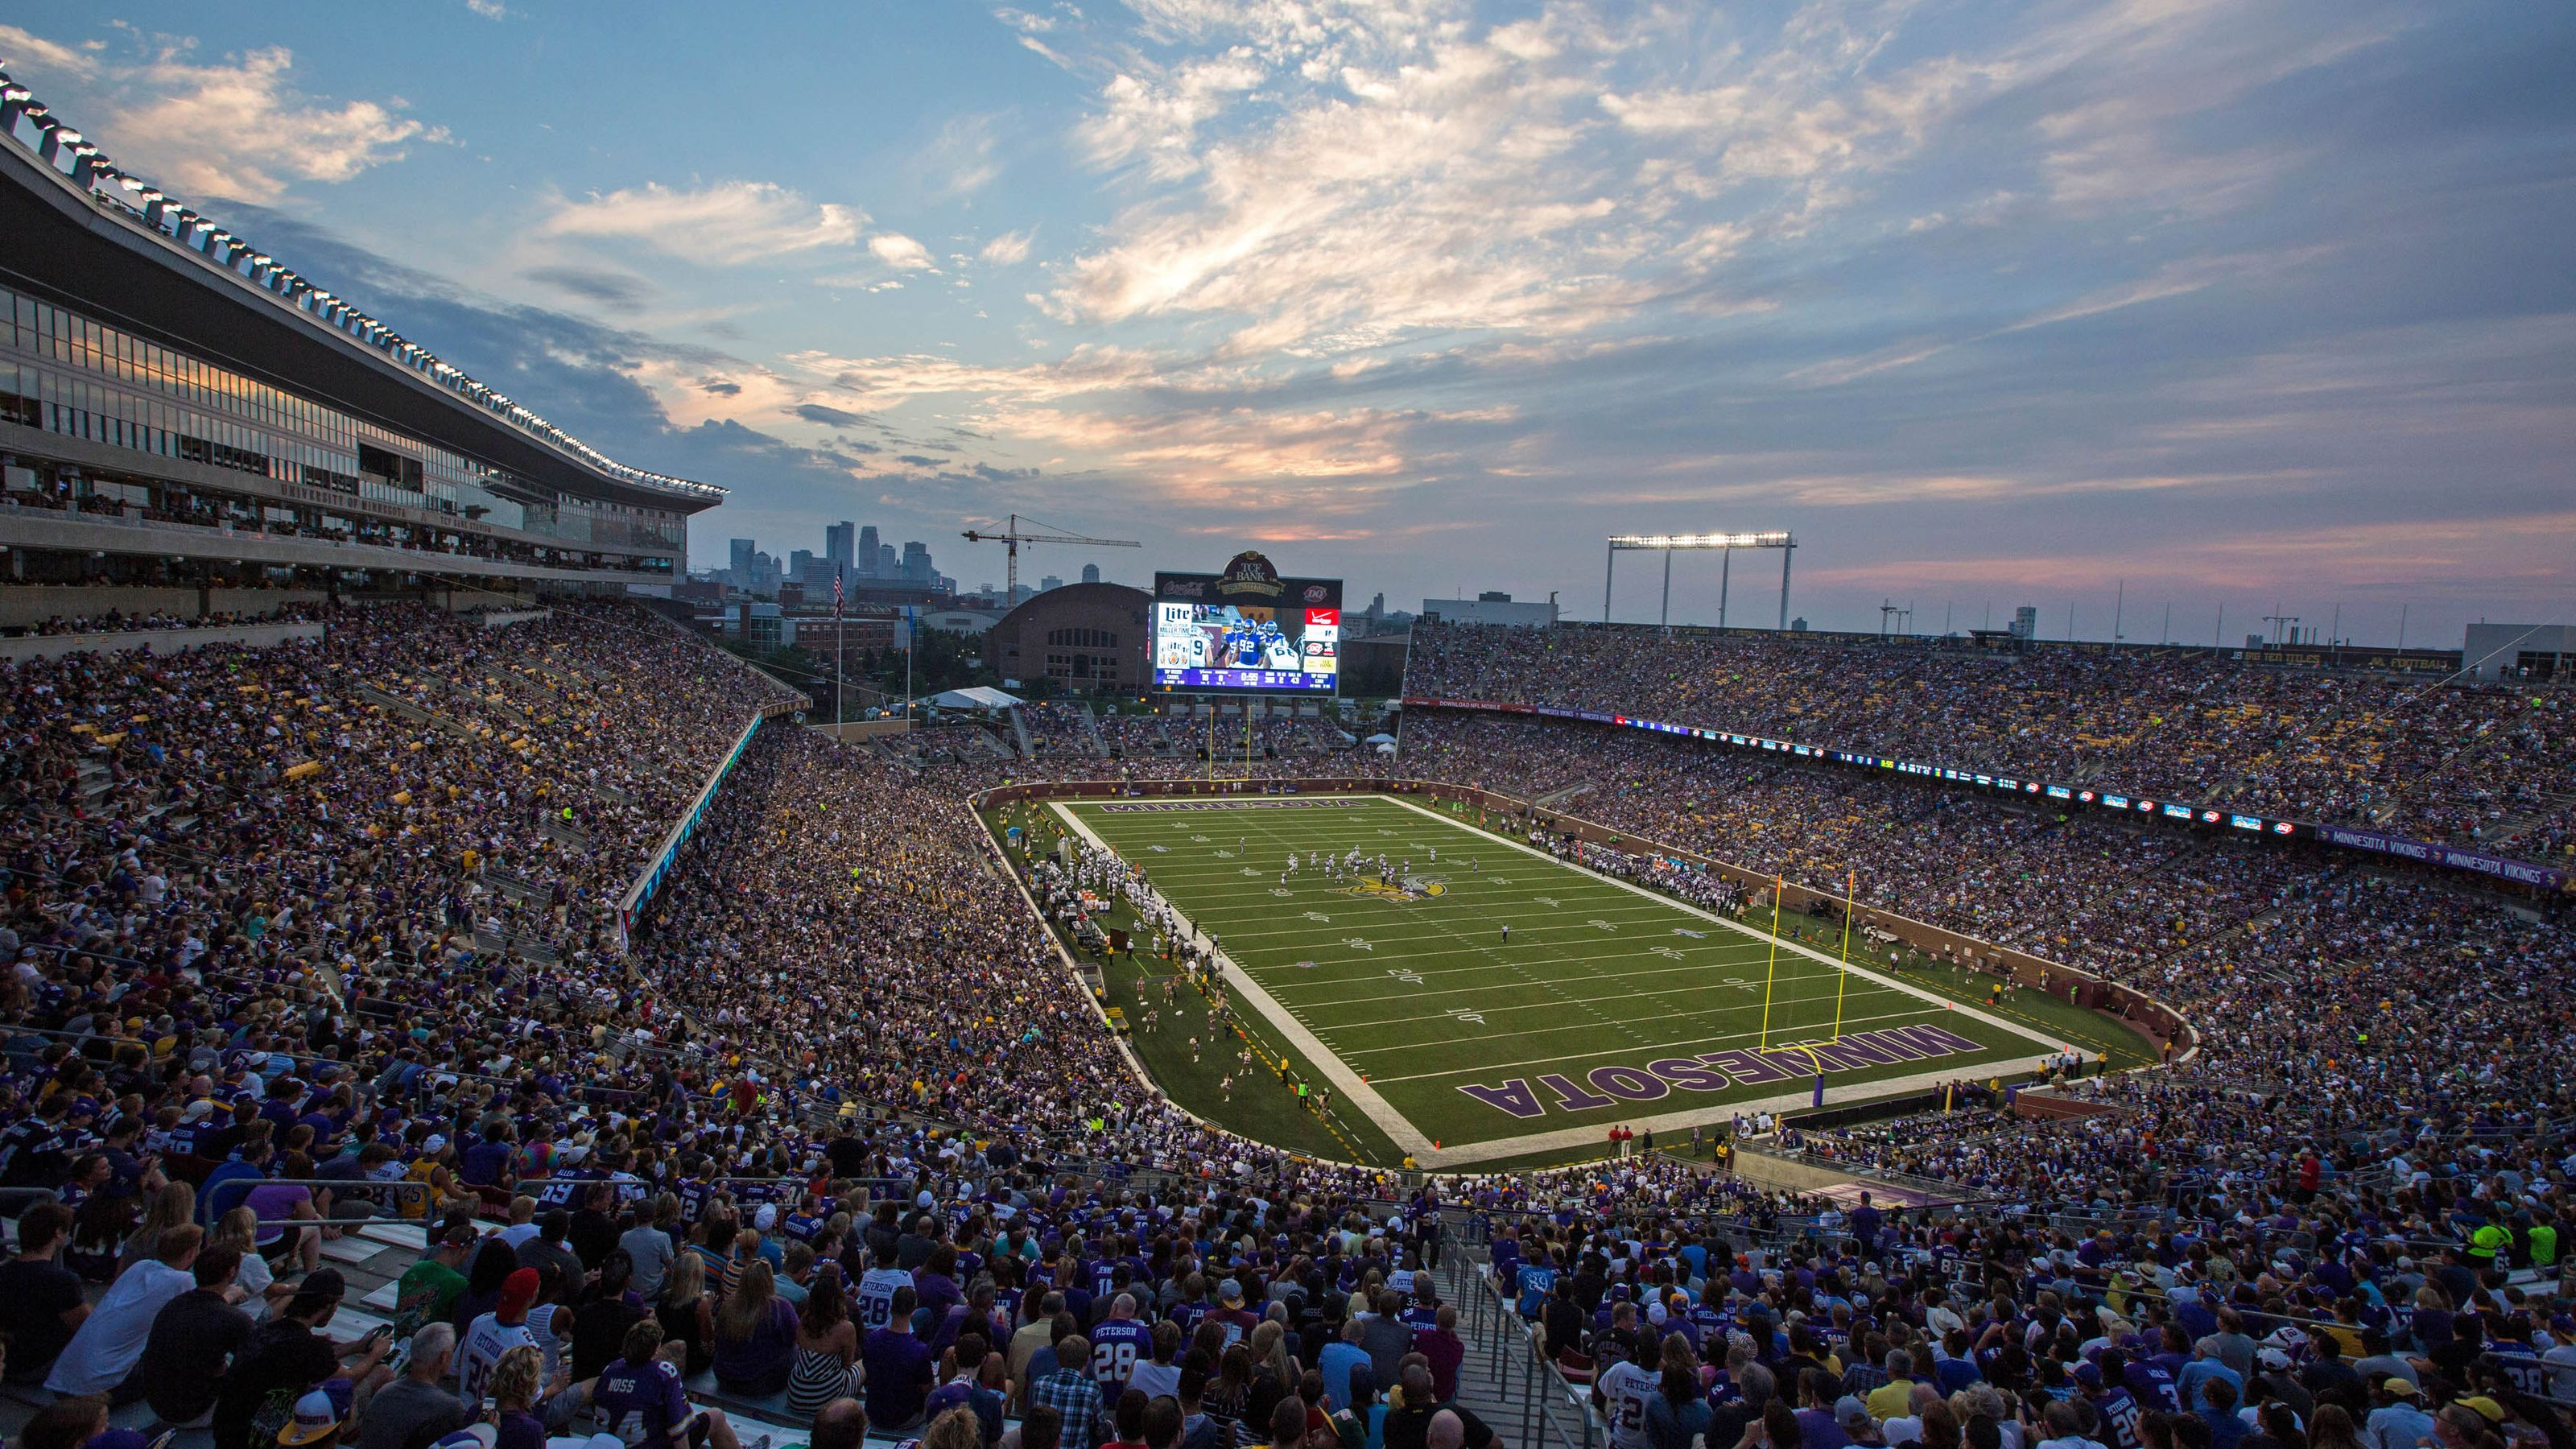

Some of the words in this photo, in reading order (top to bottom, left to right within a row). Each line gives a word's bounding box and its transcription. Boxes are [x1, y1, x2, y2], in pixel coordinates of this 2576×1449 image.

[282, 485, 344, 506] UNIVERSITY
[347, 497, 358, 509] OF
[362, 501, 405, 518] MINNESOTA
[1241, 563, 1261, 572] TCF
[1236, 572, 1265, 581] BANK
[1165, 607, 1190, 622] Lite
[1194, 640, 1203, 655] 9
[1239, 640, 1254, 652] 92
[2244, 651, 2260, 661] BIG
[2264, 653, 2283, 663] TEN
[2285, 654, 2320, 664] TITLES
[1439, 700, 1470, 708] DOWNLOAD
[1580, 712, 1600, 721] MINNESOTA
[1100, 799, 1370, 813] MINNESOTA
[2334, 831, 2386, 851] MINNESOTA
[2390, 841, 2426, 859] VIKINGS
[2446, 852, 2500, 874] MINNESOTA
[2504, 863, 2541, 884] VIKINGS
[1342, 937, 1371, 951] 30
[1387, 968, 1423, 983] 20
[1454, 1023, 1988, 1120] MINNESOTA
[557, 1170, 576, 1179] ALLEN
[863, 1281, 894, 1293] PETERSON
[1396, 1278, 1413, 1286] PETER
[1528, 1277, 1549, 1290] 89
[1406, 1298, 1420, 1307] 32
[1191, 1308, 1205, 1319] LEN
[1096, 1326, 1137, 1338] PETERSON
[1410, 1320, 1437, 1332] PETERSO
[1827, 1333, 1850, 1344] CART
[473, 1331, 502, 1360] PETERSON
[1094, 1342, 1136, 1381] 28
[608, 1377, 637, 1394] MOSS
[2105, 1395, 2132, 1417] PETERSON
[1620, 1395, 1644, 1432] 2
